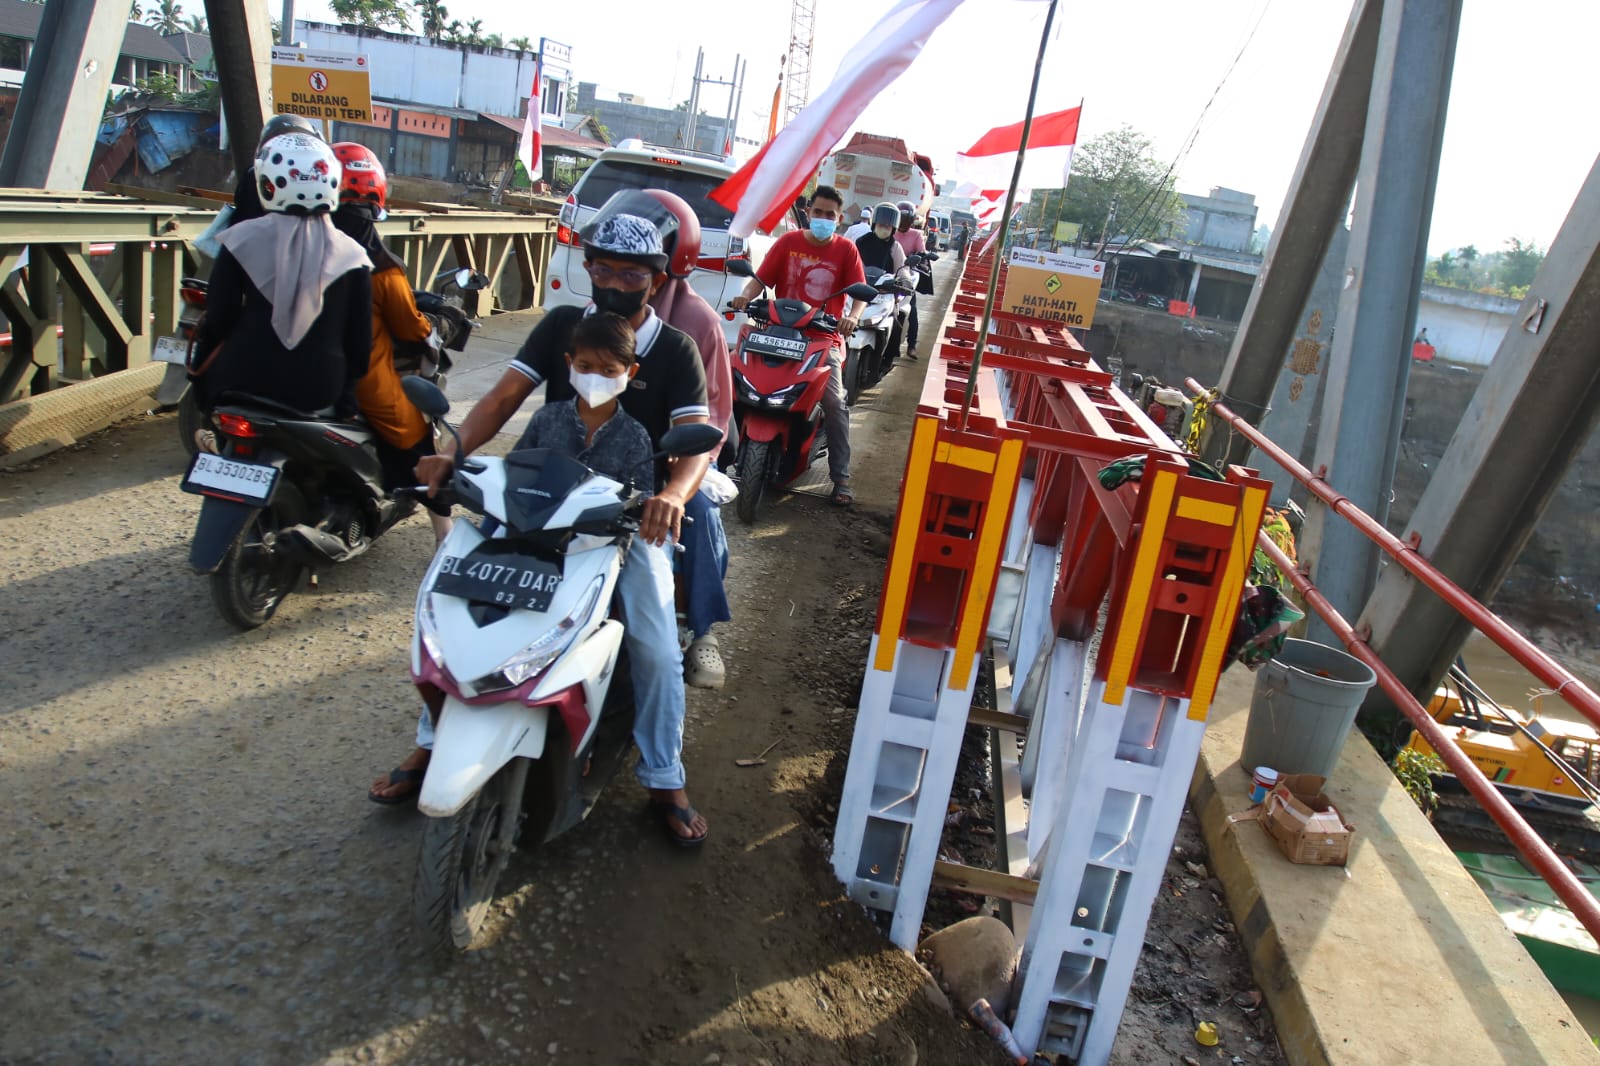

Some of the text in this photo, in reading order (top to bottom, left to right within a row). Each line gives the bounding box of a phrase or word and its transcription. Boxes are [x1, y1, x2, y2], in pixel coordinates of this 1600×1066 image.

[291, 92, 348, 107] DILARANG
[277, 103, 366, 120] BERDIRI DI TEPI
[1022, 294, 1077, 312] HATI-HATI
[1011, 305, 1084, 325] TEPI JURANG
[197, 457, 212, 473] BL
[440, 556, 558, 593] BL 4077 DAR
